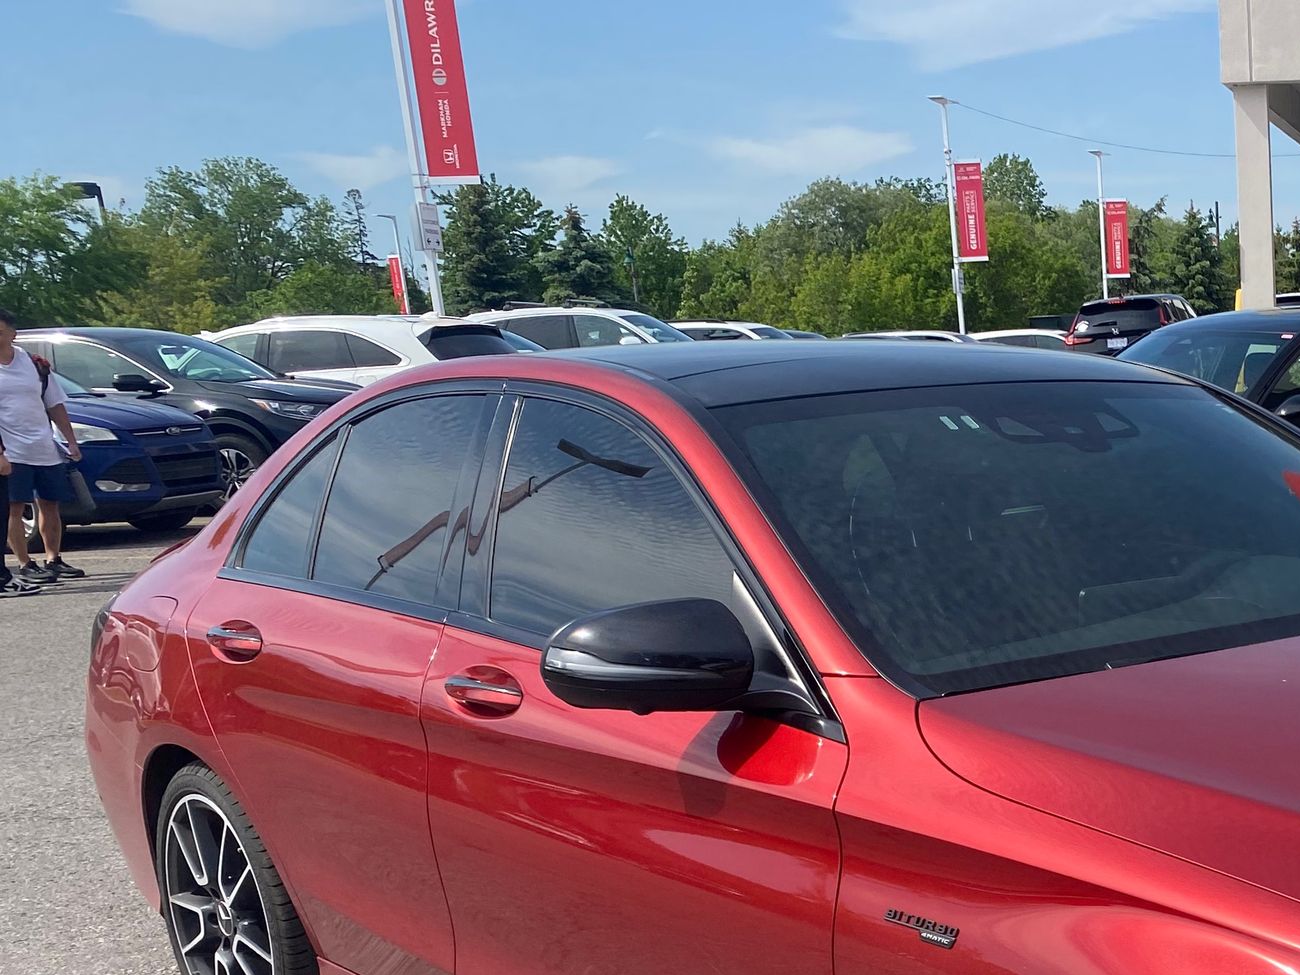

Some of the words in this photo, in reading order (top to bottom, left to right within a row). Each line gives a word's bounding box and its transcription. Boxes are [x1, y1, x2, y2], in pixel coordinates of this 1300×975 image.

[437, 99, 448, 138] MARKHAM
[443, 99, 452, 127] HONDA
[967, 213, 978, 250] GENUINE
[884, 909, 958, 937] BITURBO
[920, 932, 951, 945] 4MATIC
